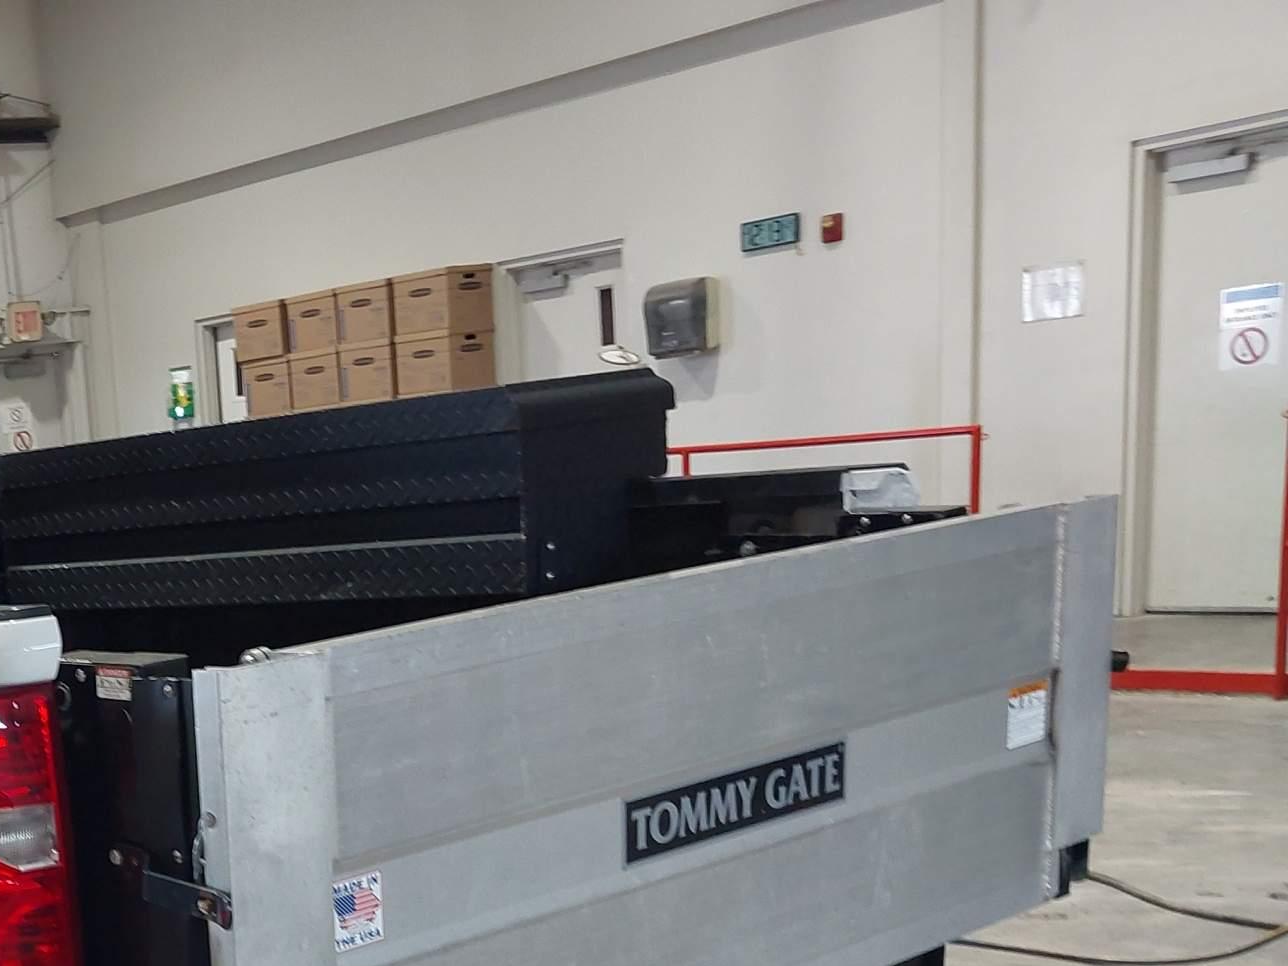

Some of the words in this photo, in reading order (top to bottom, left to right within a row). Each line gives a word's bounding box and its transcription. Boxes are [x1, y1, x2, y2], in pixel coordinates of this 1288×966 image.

[630, 775, 758, 851] TOMMY
[764, 751, 842, 810] GATE
[331, 879, 364, 896] MADE
[366, 872, 379, 892] IN
[334, 935, 358, 951] THE
[358, 927, 382, 944] USA
